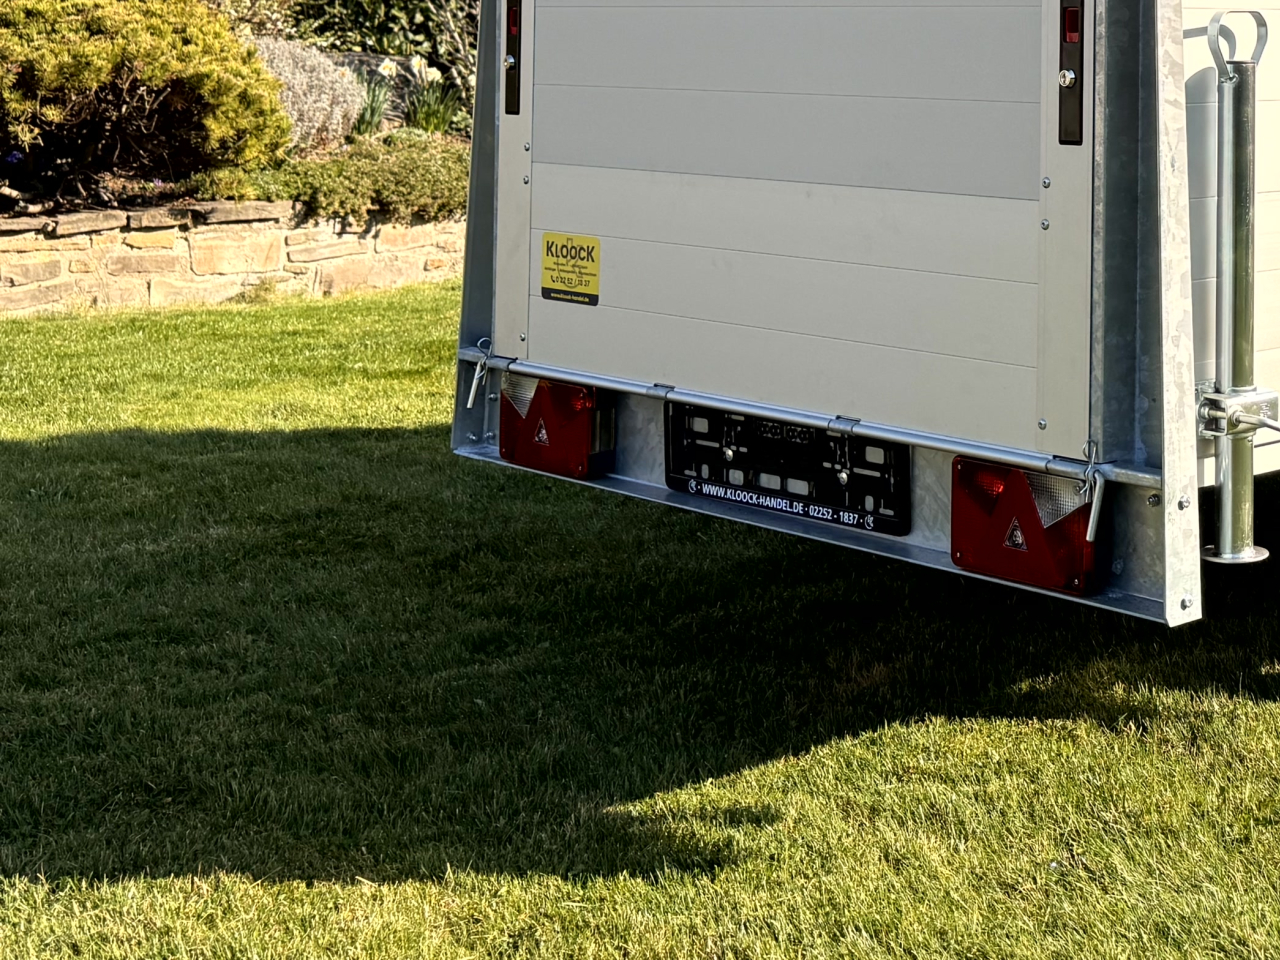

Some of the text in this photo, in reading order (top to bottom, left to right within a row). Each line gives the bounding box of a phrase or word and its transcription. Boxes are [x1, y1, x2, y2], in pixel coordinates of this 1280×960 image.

[546, 240, 595, 263] KLOOCK
[701, 483, 804, 515] WWW.KLOOCK-HANDEL.DE
[809, 507, 833, 520] 02252
[839, 512, 858, 525] 1837
